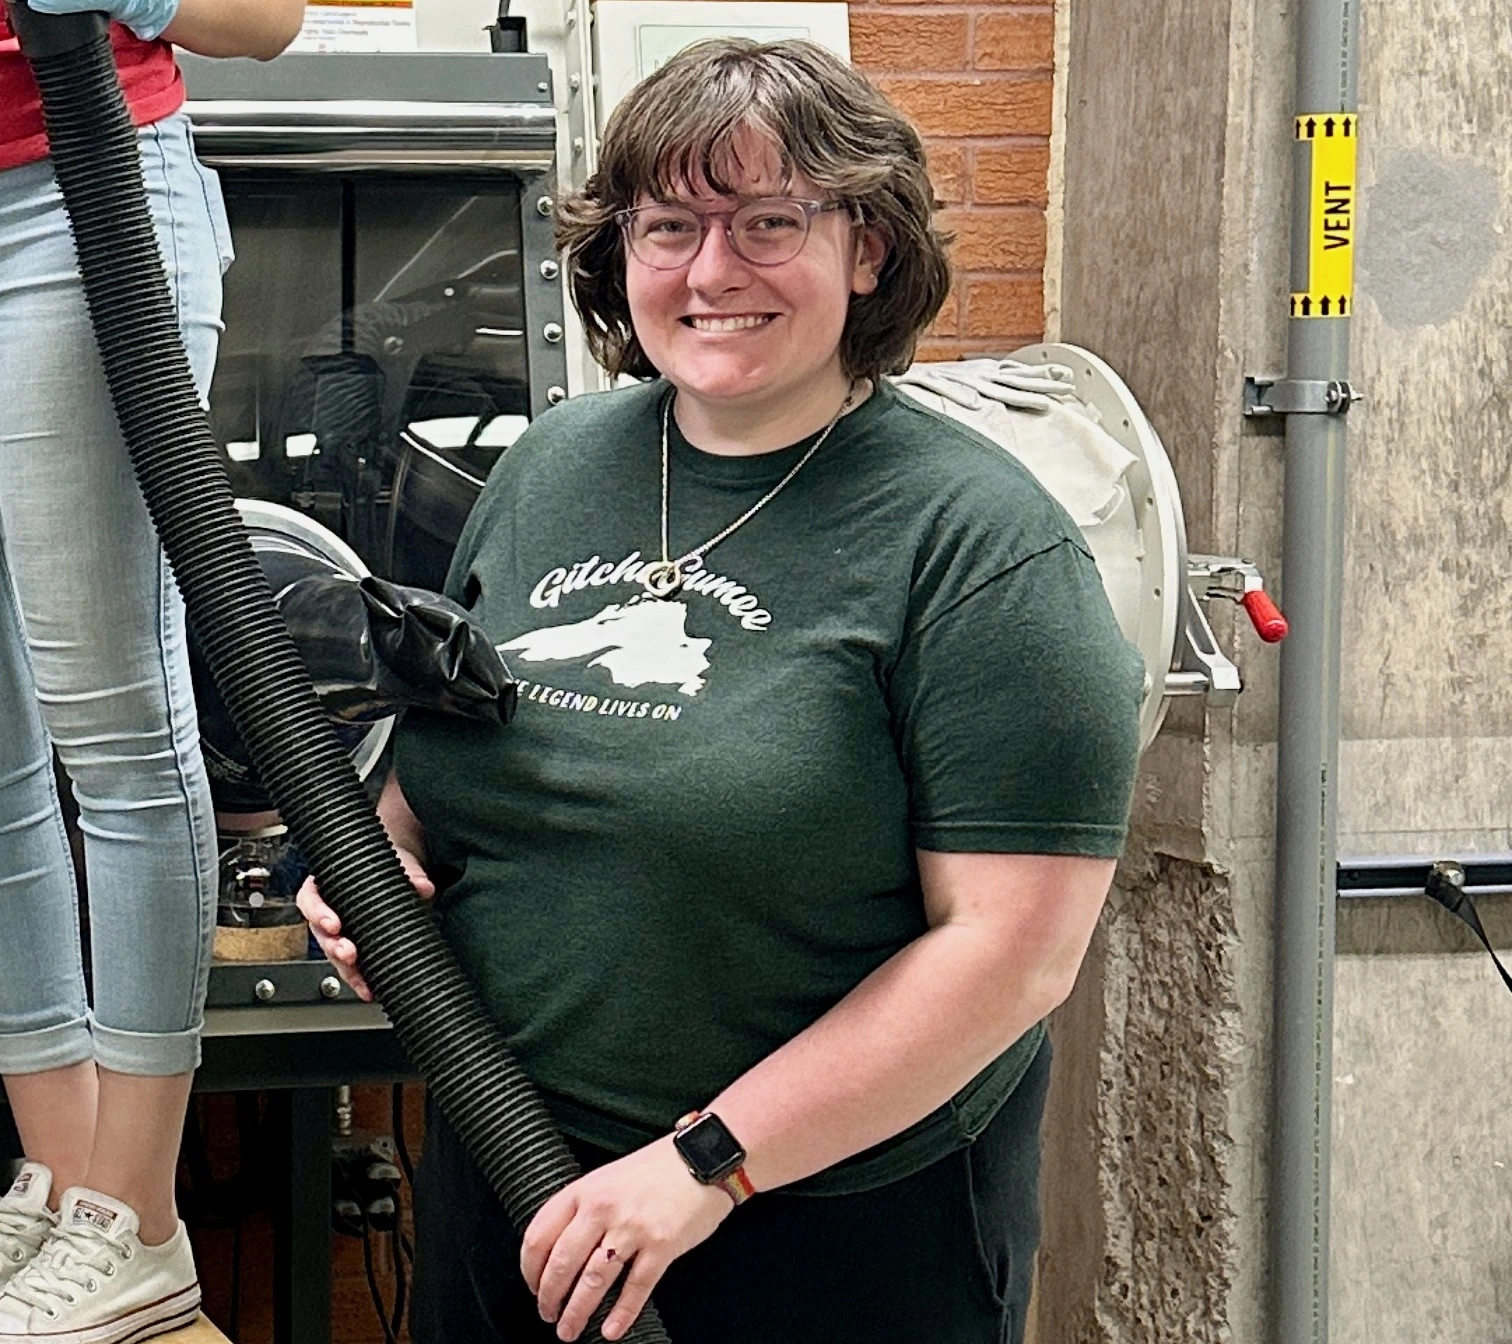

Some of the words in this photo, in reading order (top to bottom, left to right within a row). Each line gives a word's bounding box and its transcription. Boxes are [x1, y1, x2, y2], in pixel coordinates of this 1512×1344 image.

[1323, 181, 1352, 250] VENT
[529, 551, 652, 609] Gitch
[529, 684, 598, 712] LEGEND
[599, 699, 648, 718] LIVES
[651, 704, 682, 721] ON
